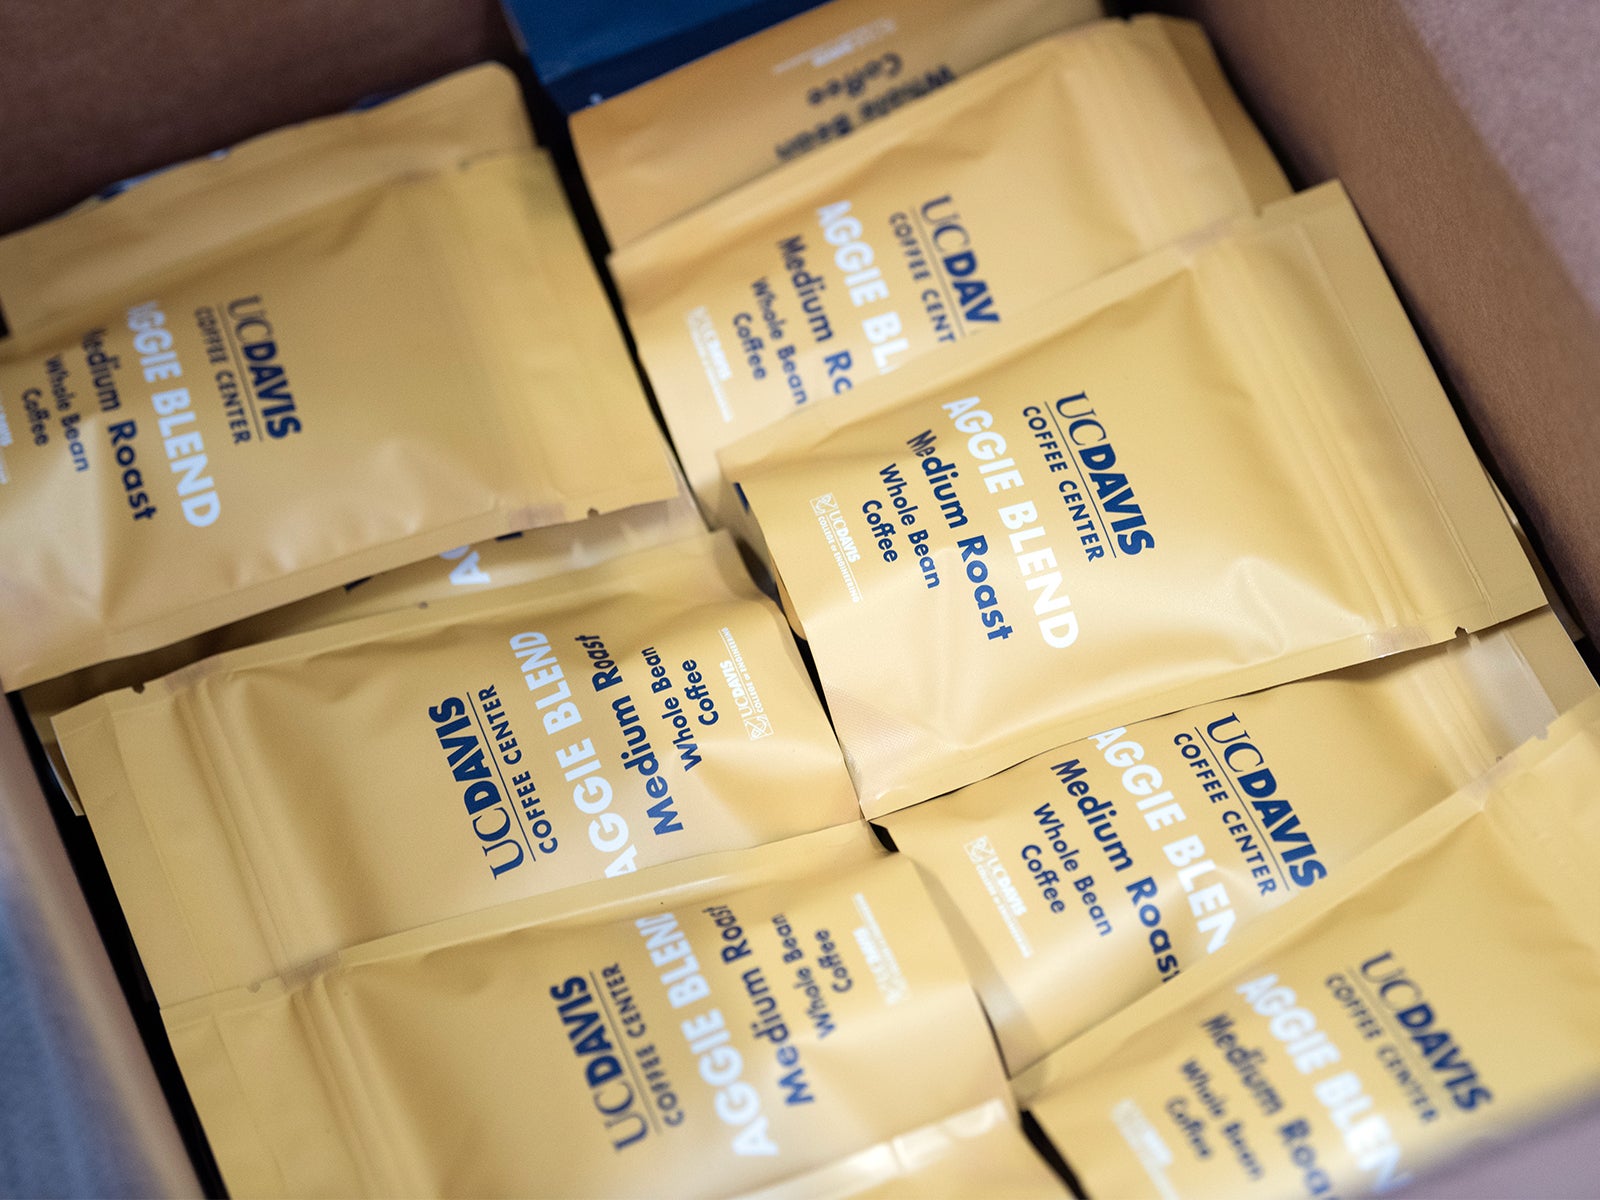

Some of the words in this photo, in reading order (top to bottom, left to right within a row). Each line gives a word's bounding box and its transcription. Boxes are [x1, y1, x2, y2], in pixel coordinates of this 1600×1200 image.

[778, 234, 834, 342] Medium
[816, 200, 889, 307] AGGIE
[889, 211, 930, 281] COFFEE
[921, 193, 1000, 324] UCDAV
[733, 312, 767, 380] Coffee
[750, 276, 787, 340] Whole
[776, 344, 808, 405] Bean
[842, 311, 909, 375] BL
[22, 388, 50, 447] Coffee
[61, 412, 90, 473] Bean
[151, 387, 221, 528] BLEND
[215, 370, 252, 445] CENTER
[107, 419, 157, 521] Roast
[1022, 405, 1068, 473] COFFEE
[1058, 480, 1105, 562] CENTER
[1055, 391, 1155, 557] UCDAVIS
[861, 500, 898, 563] Coffee
[879, 463, 916, 526] Whole
[908, 529, 941, 589] Bean
[907, 429, 969, 529] Medium
[957, 534, 1013, 641] Roast
[942, 396, 1025, 494] AGGIE
[998, 500, 1080, 649] BLEND
[509, 631, 582, 735] BLEND
[575, 634, 623, 692] Roast
[641, 646, 673, 694] Bean
[682, 658, 719, 726] Coffee
[478, 684, 522, 765] CENTER
[611, 695, 683, 836] Medium
[662, 696, 702, 772] Whole
[429, 696, 525, 880] UCDAVIS
[512, 771, 558, 854] COFFEE
[556, 737, 638, 879] AGGIE
[1050, 759, 1133, 872] Medium
[1087, 726, 1187, 832] AGGIE
[1173, 732, 1229, 804] COFFEE
[1222, 810, 1277, 896] CENTER
[1206, 712, 1327, 888] UCDAVIS
[1021, 844, 1065, 914] Coffee
[1033, 802, 1080, 872] Whole
[1074, 875, 1113, 936] Bean
[771, 914, 803, 964] Bean
[815, 929, 853, 994] Coffee
[602, 963, 646, 1038] CENTER
[740, 967, 815, 1107] Medium
[795, 967, 836, 1040] Whole
[1236, 973, 1341, 1074] AGGIE
[636, 1044, 684, 1126] COFFEE
[681, 1008, 779, 1157] AGGIE
[1203, 1012, 1284, 1116] Medium
